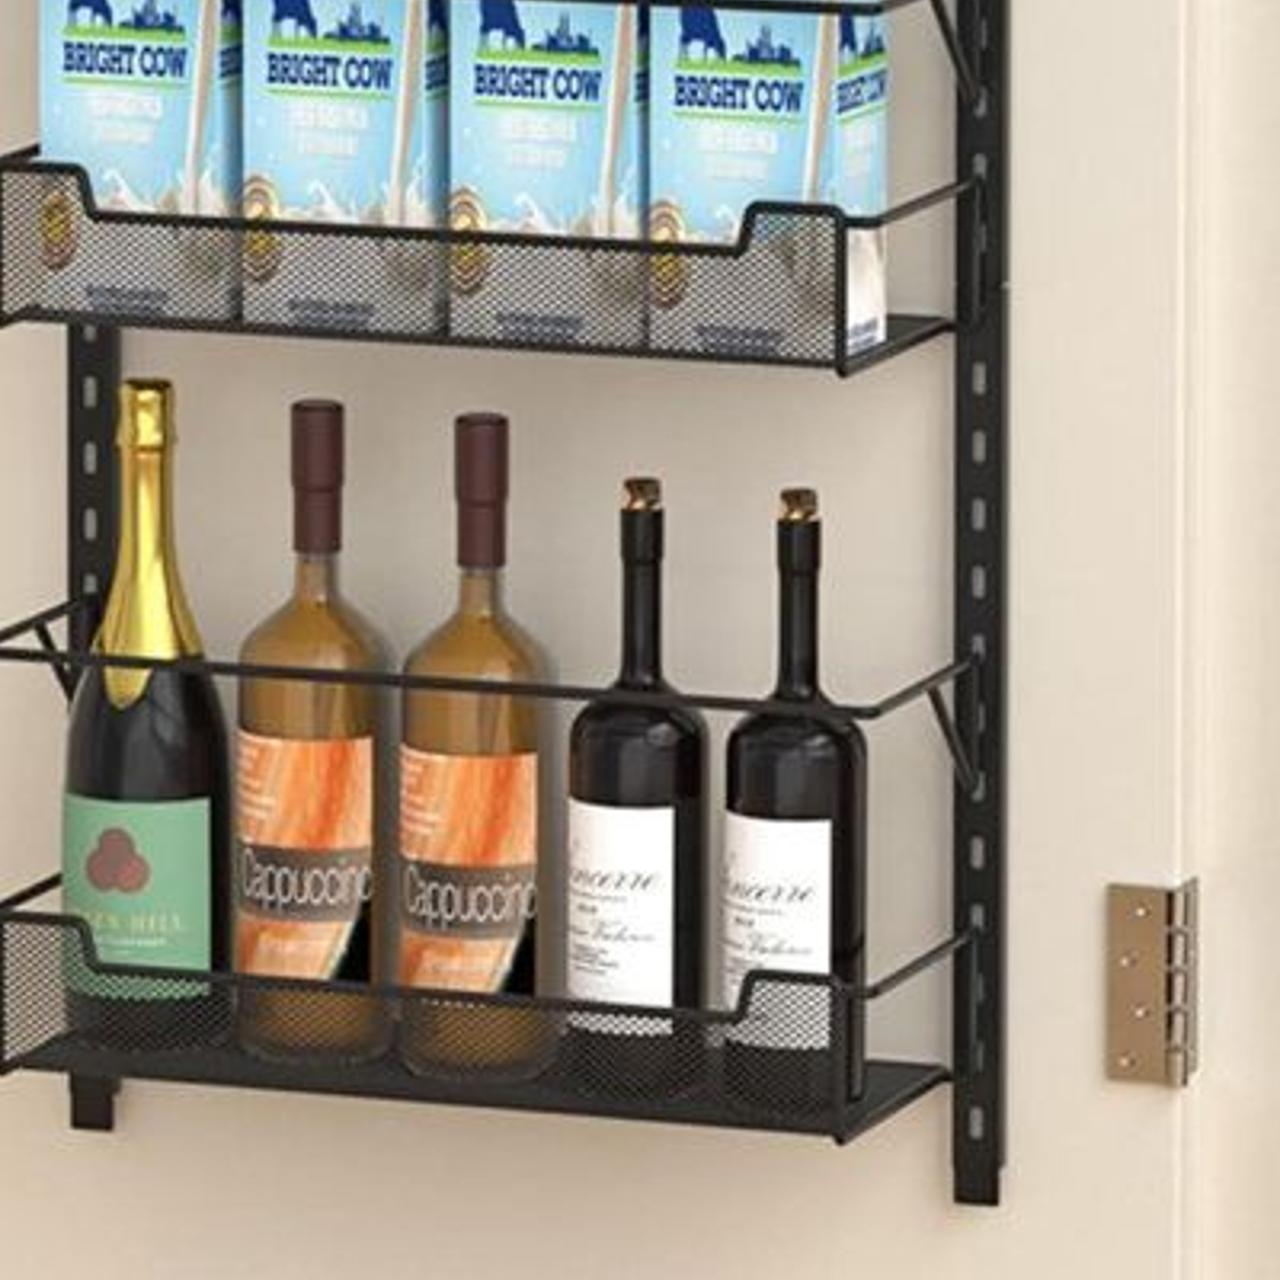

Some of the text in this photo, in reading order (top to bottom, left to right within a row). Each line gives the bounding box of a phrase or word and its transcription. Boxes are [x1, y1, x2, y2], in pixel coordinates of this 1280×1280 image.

[62, 41, 188, 79] BRIGHT COW
[266, 51, 392, 90] BRIGHT COW
[473, 62, 602, 102] BRIGHT COW
[673, 74, 804, 113] BRIGHT COW
[241, 848, 372, 910] Cappuccino
[407, 865, 538, 932] Cappuccino
